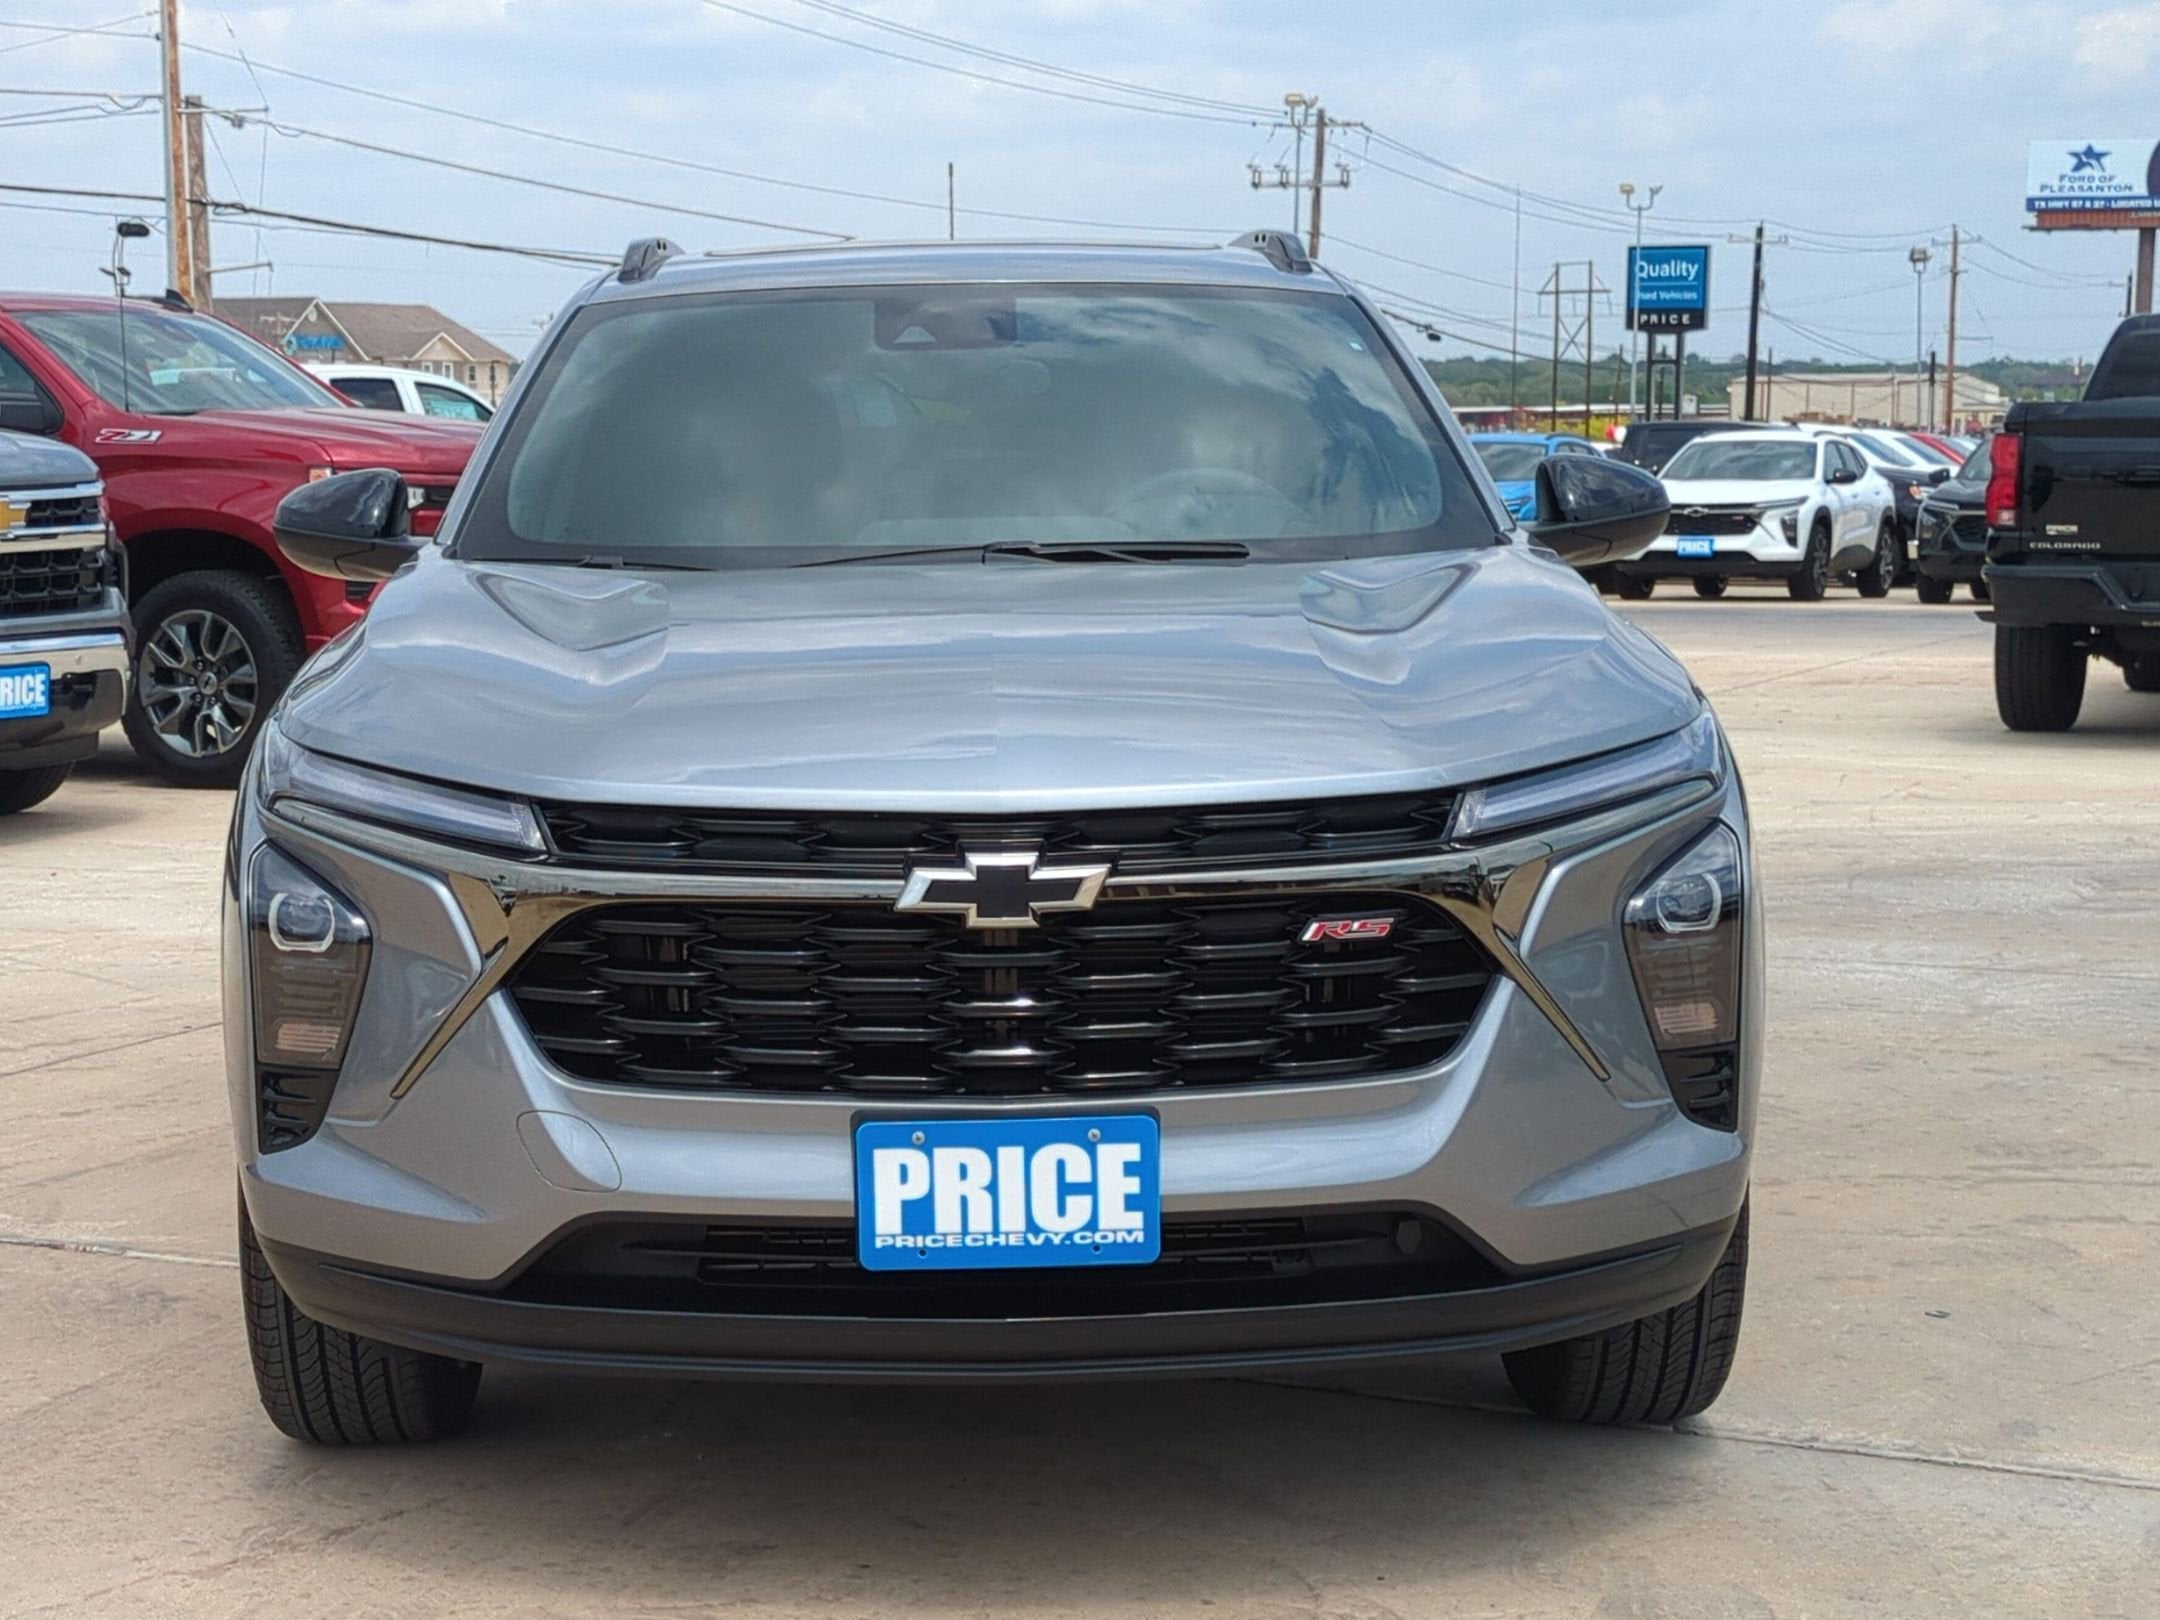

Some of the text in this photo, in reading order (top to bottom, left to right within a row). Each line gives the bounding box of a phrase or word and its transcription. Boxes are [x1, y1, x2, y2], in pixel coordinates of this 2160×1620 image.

[2040, 184, 2134, 193] PLEASANTON
[1635, 259, 1698, 281] Quality
[1659, 290, 1698, 301] Vehicles
[1640, 313, 1691, 325] PRICE
[95, 428, 162, 445] Z71
[1679, 540, 1711, 554] PRICE
[2030, 541, 2101, 550] COLORADO
[0, 673, 46, 707] RICE
[1301, 917, 1395, 941] RS
[873, 1142, 1145, 1235] PRICE
[875, 1230, 1145, 1249] PRICECHEVY.COM
